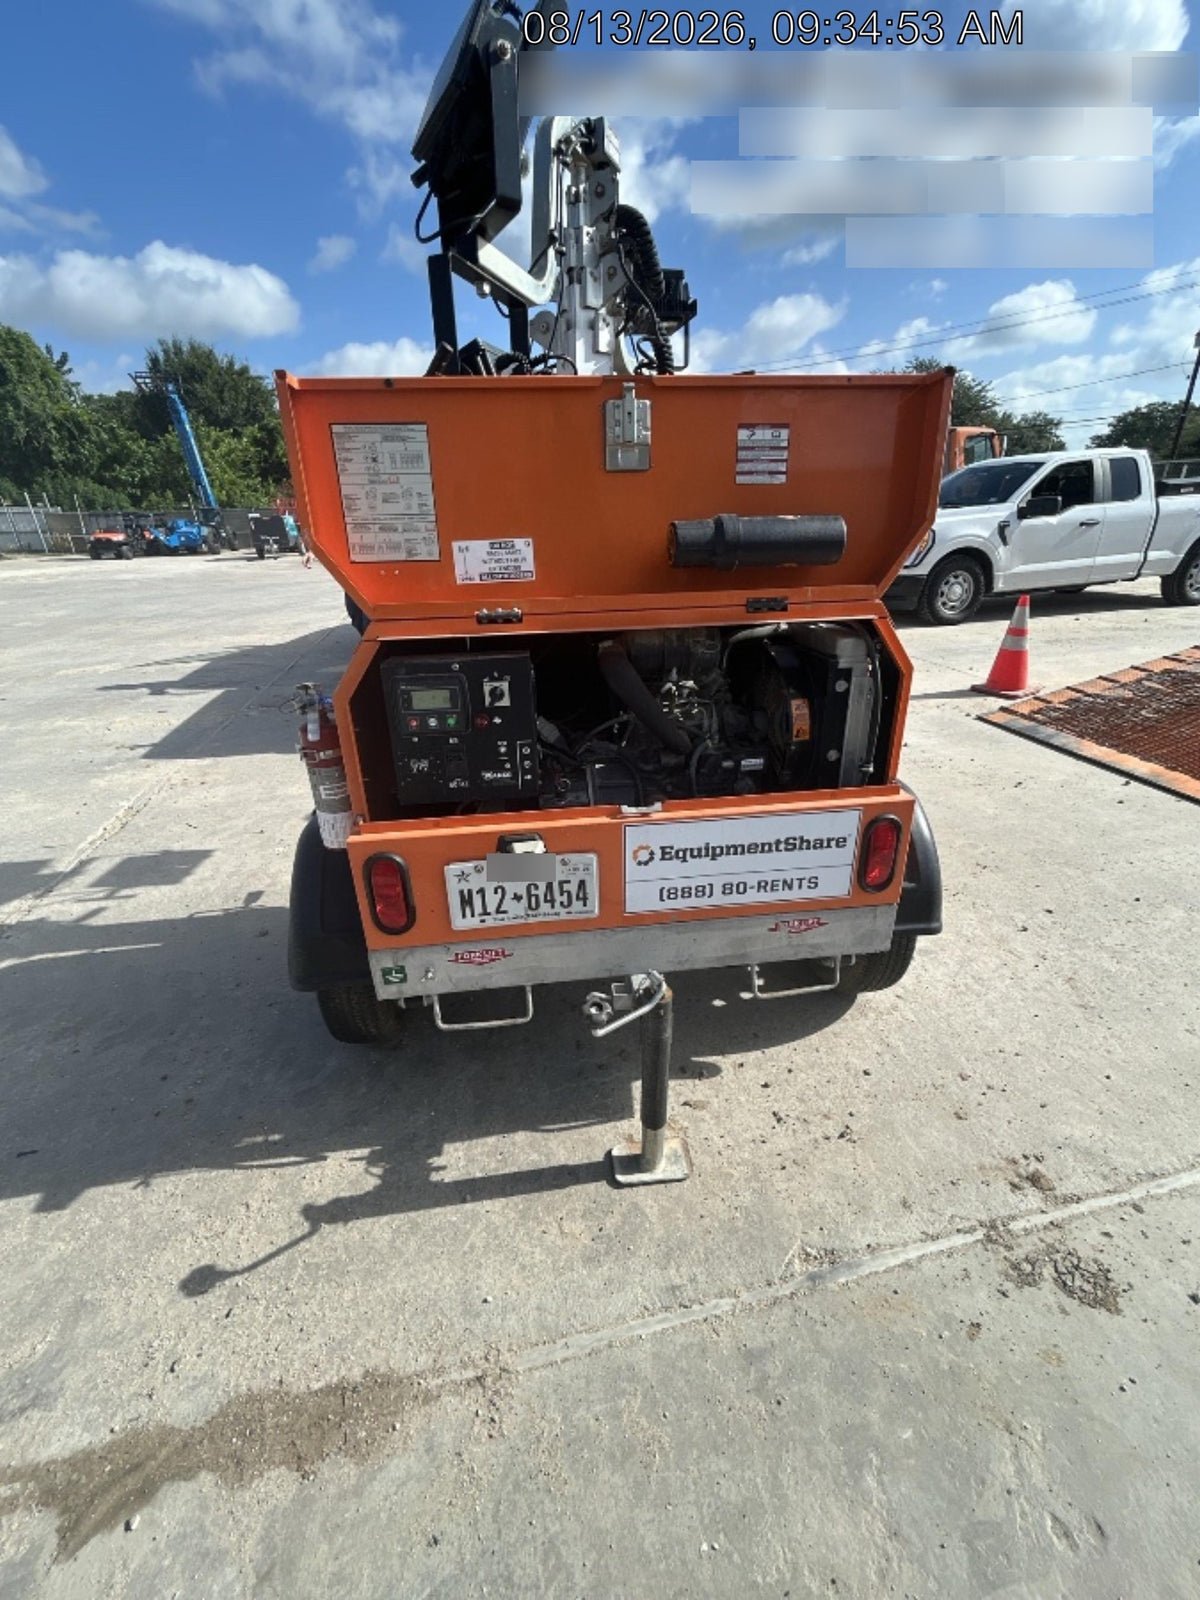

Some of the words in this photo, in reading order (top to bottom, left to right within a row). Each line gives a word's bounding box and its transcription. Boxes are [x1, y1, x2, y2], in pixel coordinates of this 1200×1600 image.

[659, 835, 848, 863] EquipmentShare
[659, 883, 714, 902] (888)
[721, 876, 820, 896] 80-RENTS
